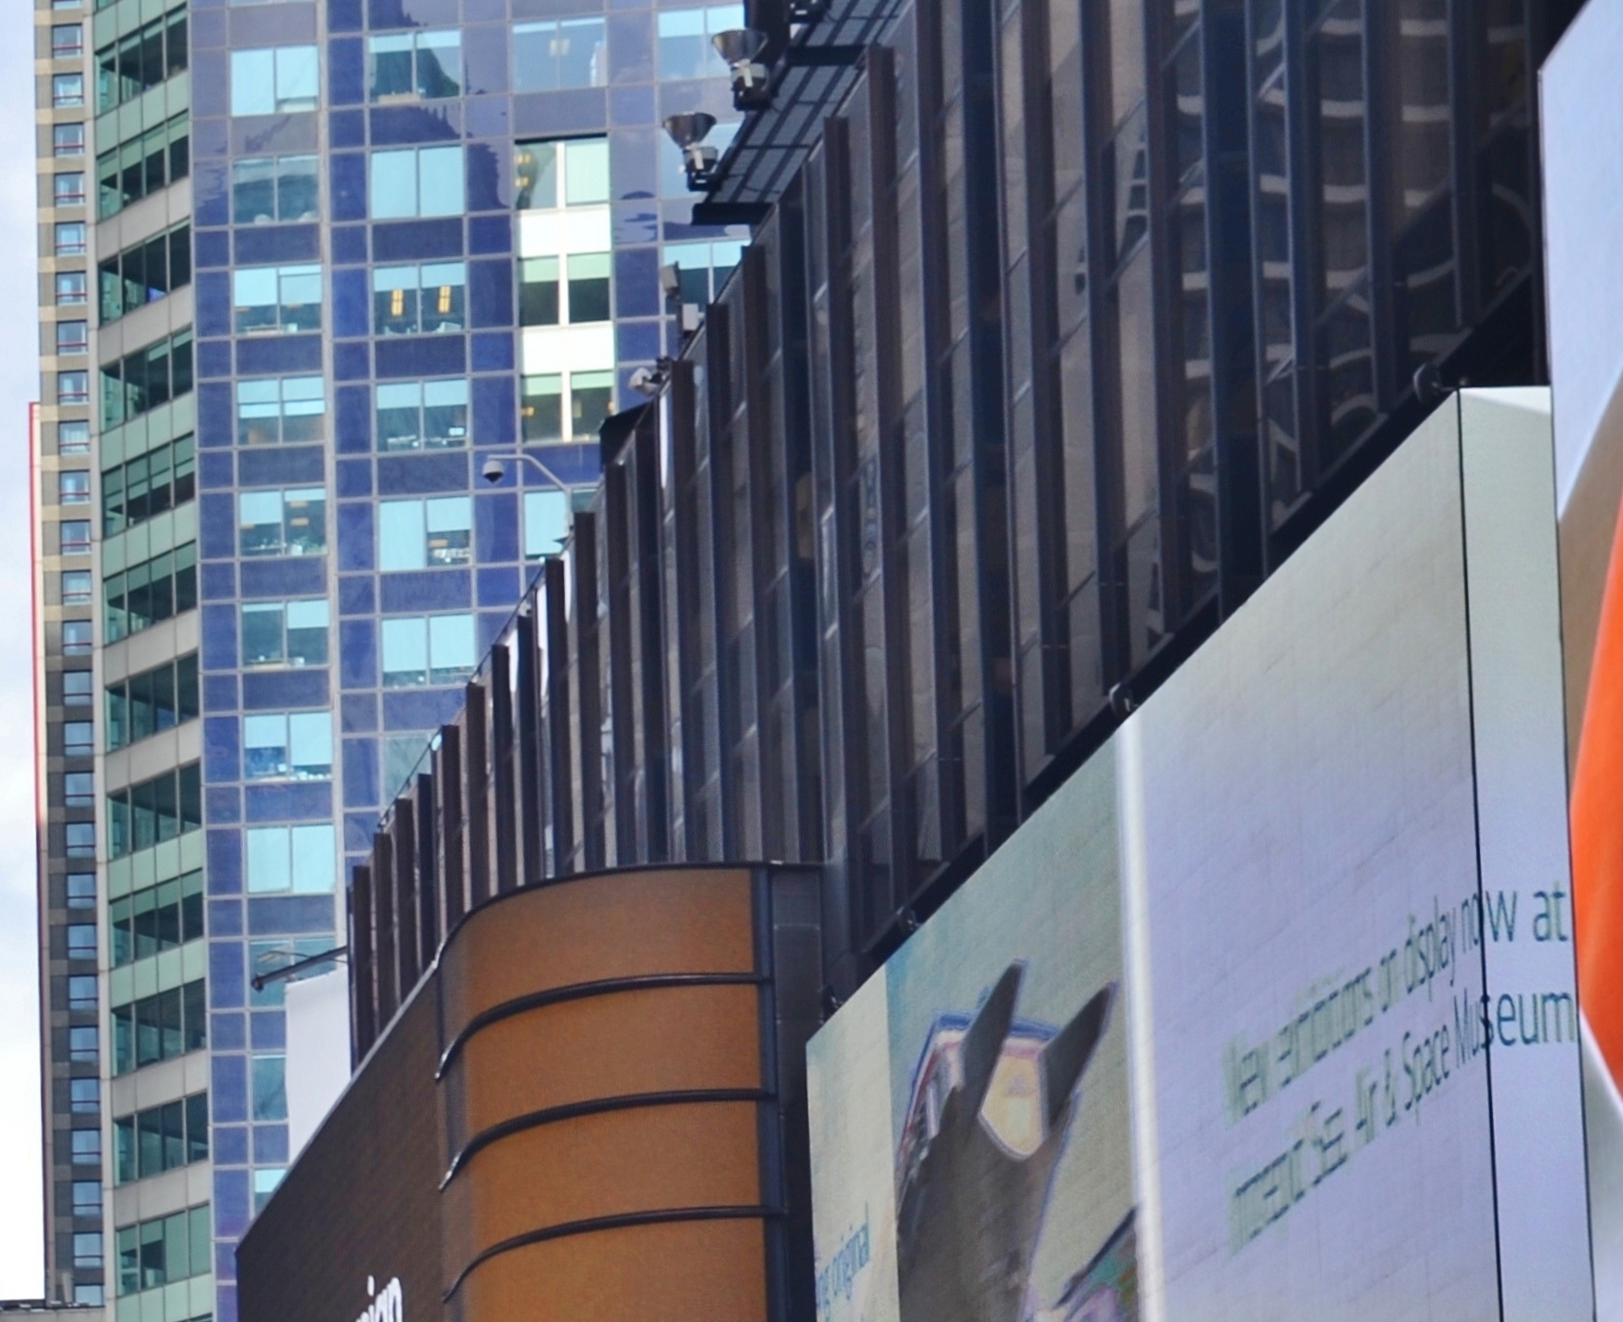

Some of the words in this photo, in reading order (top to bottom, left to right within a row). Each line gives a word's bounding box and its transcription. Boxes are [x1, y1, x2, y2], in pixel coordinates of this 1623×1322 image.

[1403, 895, 1456, 1003] display
[1461, 891, 1518, 954] now
[1532, 882, 1569, 943] at
[1401, 1024, 1451, 1129] Space
[1454, 987, 1577, 1069] Museum
